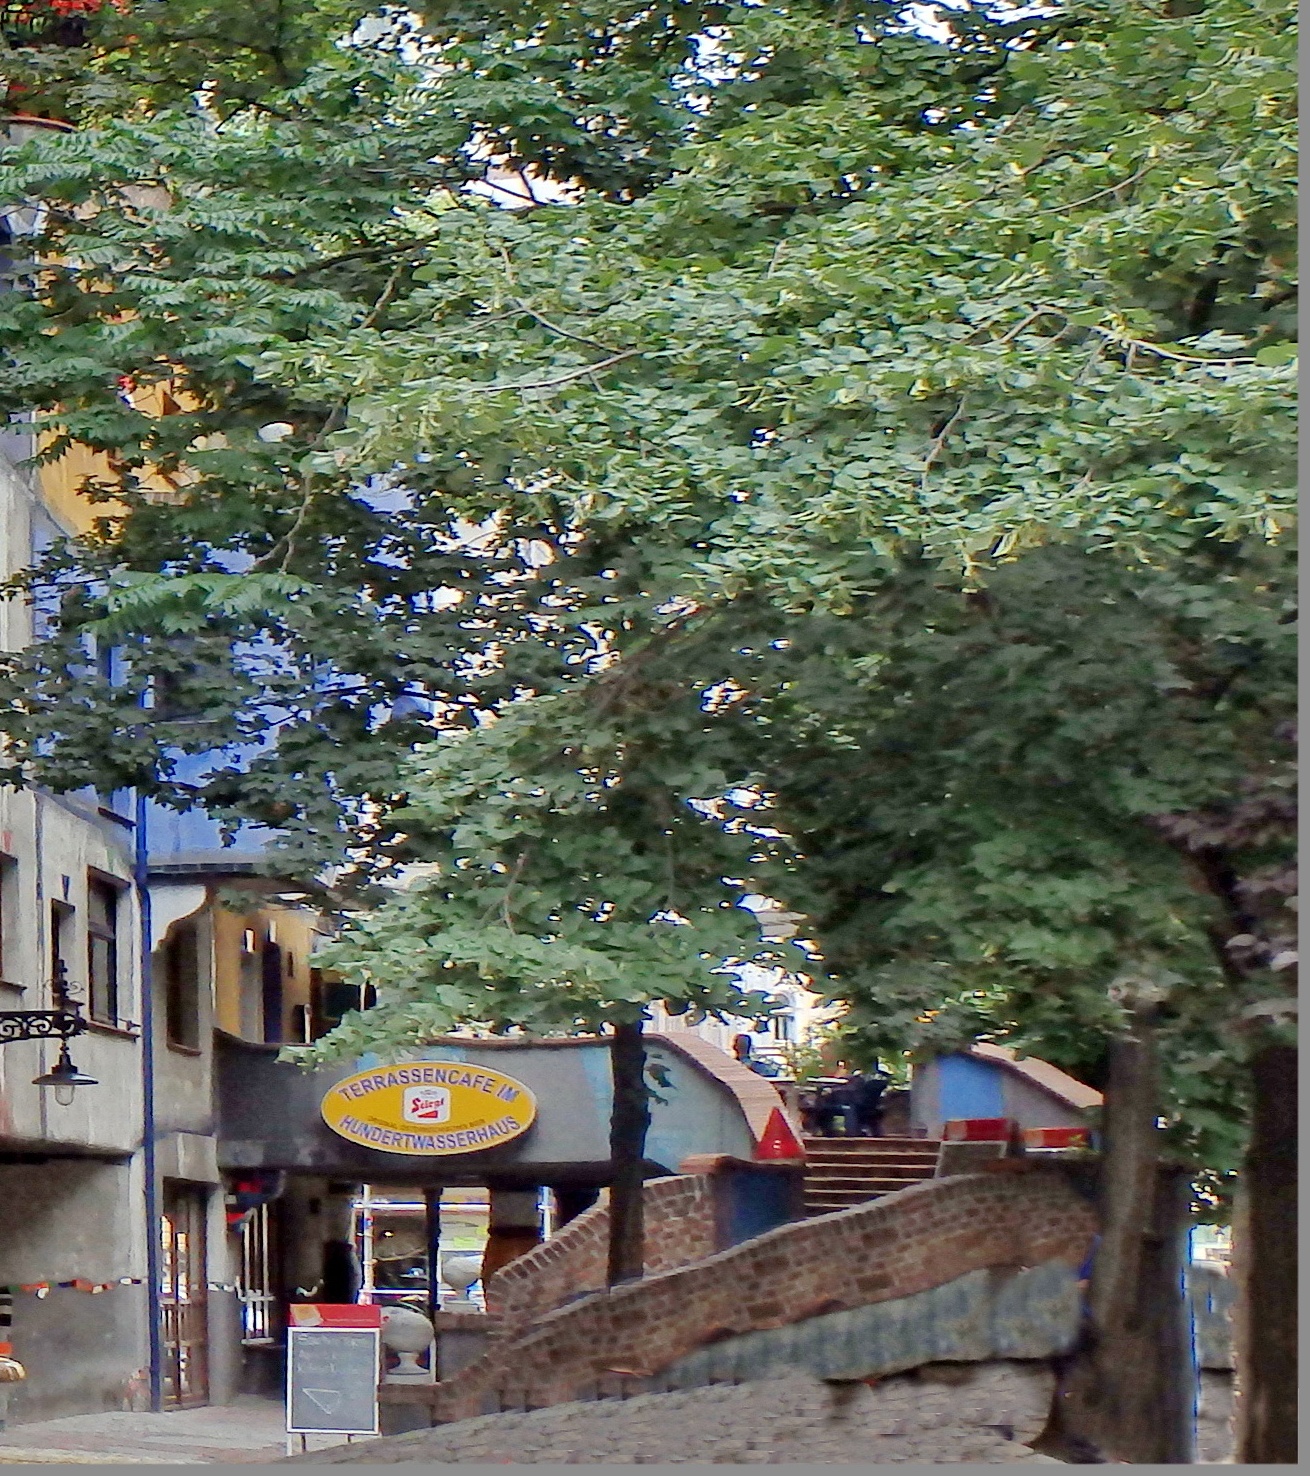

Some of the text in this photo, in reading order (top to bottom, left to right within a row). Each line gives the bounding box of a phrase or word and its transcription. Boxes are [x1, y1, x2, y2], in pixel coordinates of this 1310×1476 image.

[338, 1068, 520, 1103] TERRASSENCAFE IM
[339, 1115, 521, 1150] HUNDERTWASSERHAUS
